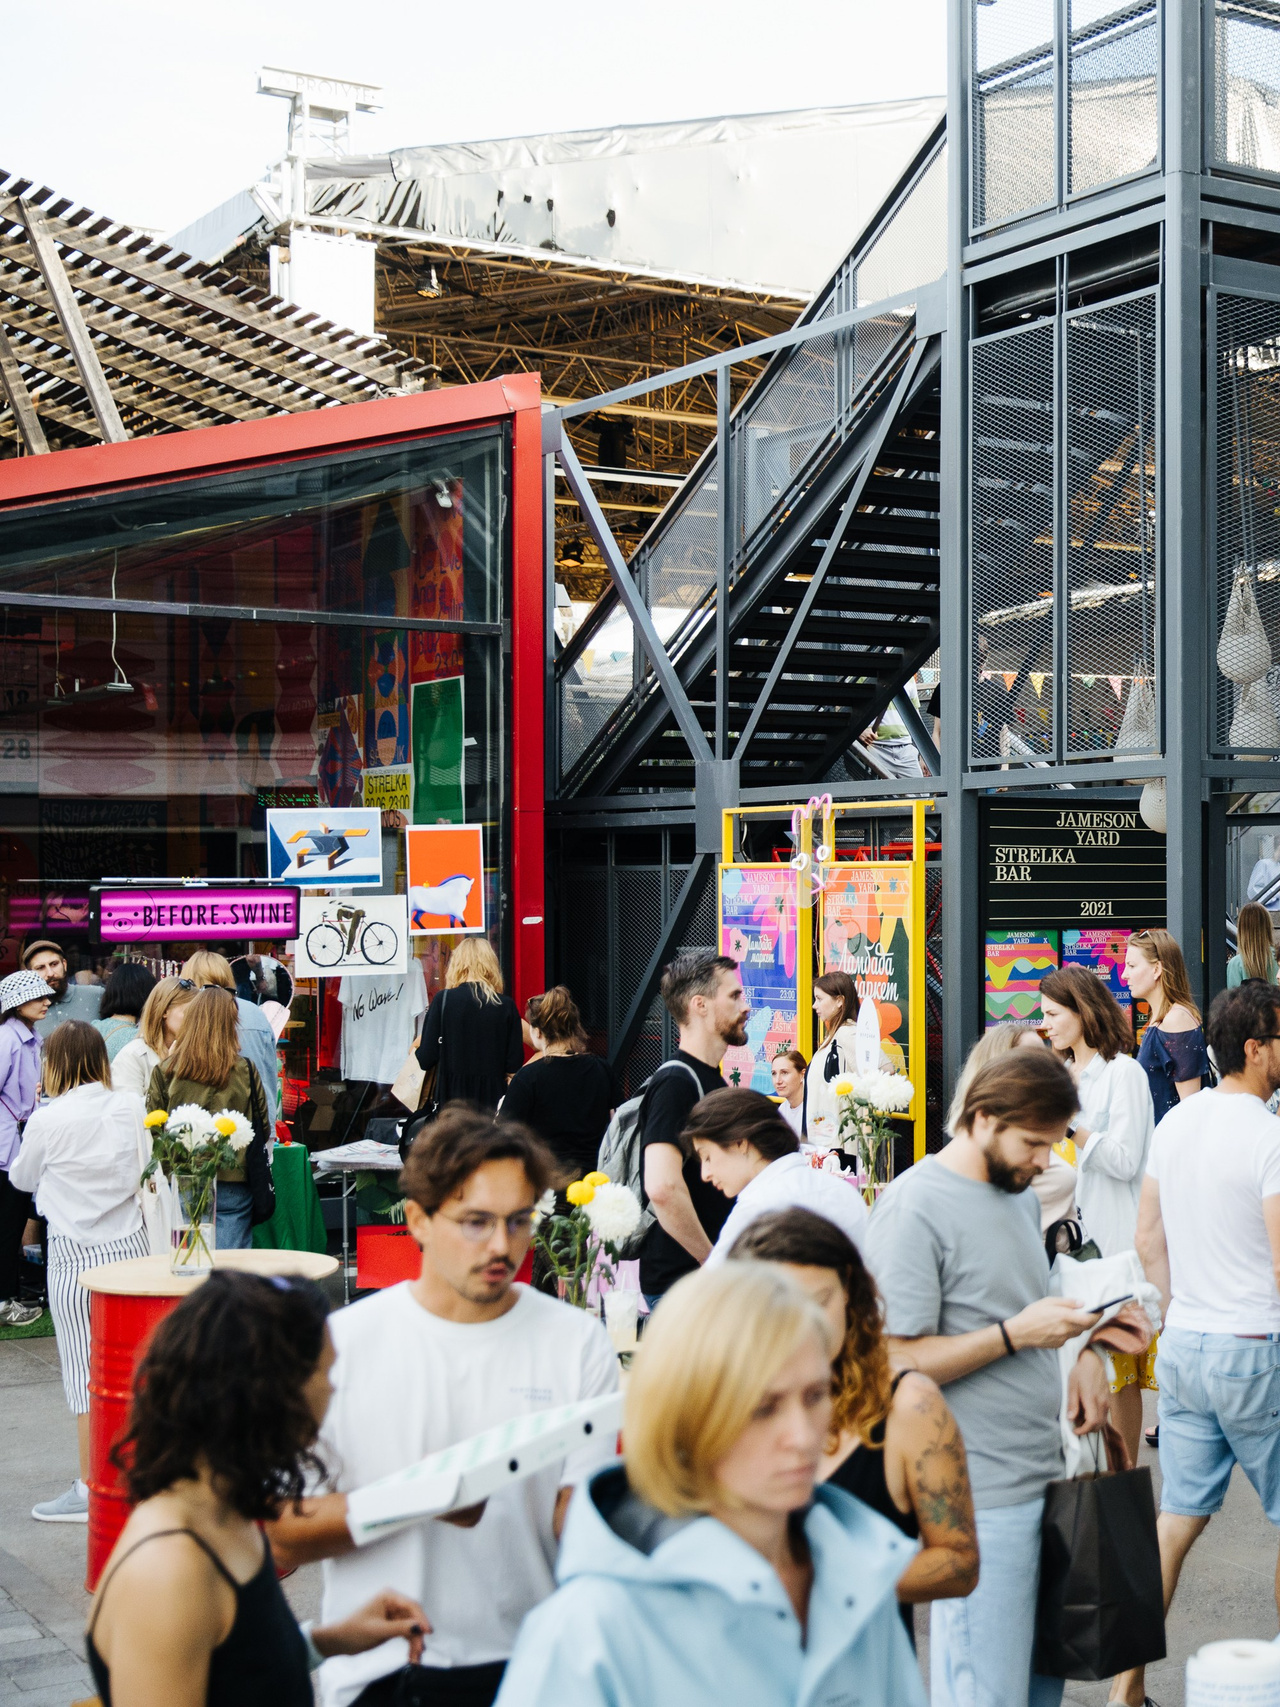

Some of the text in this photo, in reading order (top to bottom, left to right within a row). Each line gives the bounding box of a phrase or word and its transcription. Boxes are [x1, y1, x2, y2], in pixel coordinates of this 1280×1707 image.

[368, 774, 408, 794] STRELKA
[1056, 812, 1137, 829] JAMESON
[1074, 830, 1120, 846] YARD
[995, 847, 1077, 864] STRELKA
[851, 871, 885, 881] JAMESON
[995, 865, 1032, 882] BAR
[858, 882, 878, 893] YARD
[826, 895, 858, 905] STRELKA
[143, 903, 292, 927] BEFORE.SWINE
[826, 906, 842, 916] BAR
[1080, 901, 1114, 916] 2021
[838, 943, 895, 976] Ламбада
[780, 990, 795, 999] 23:00
